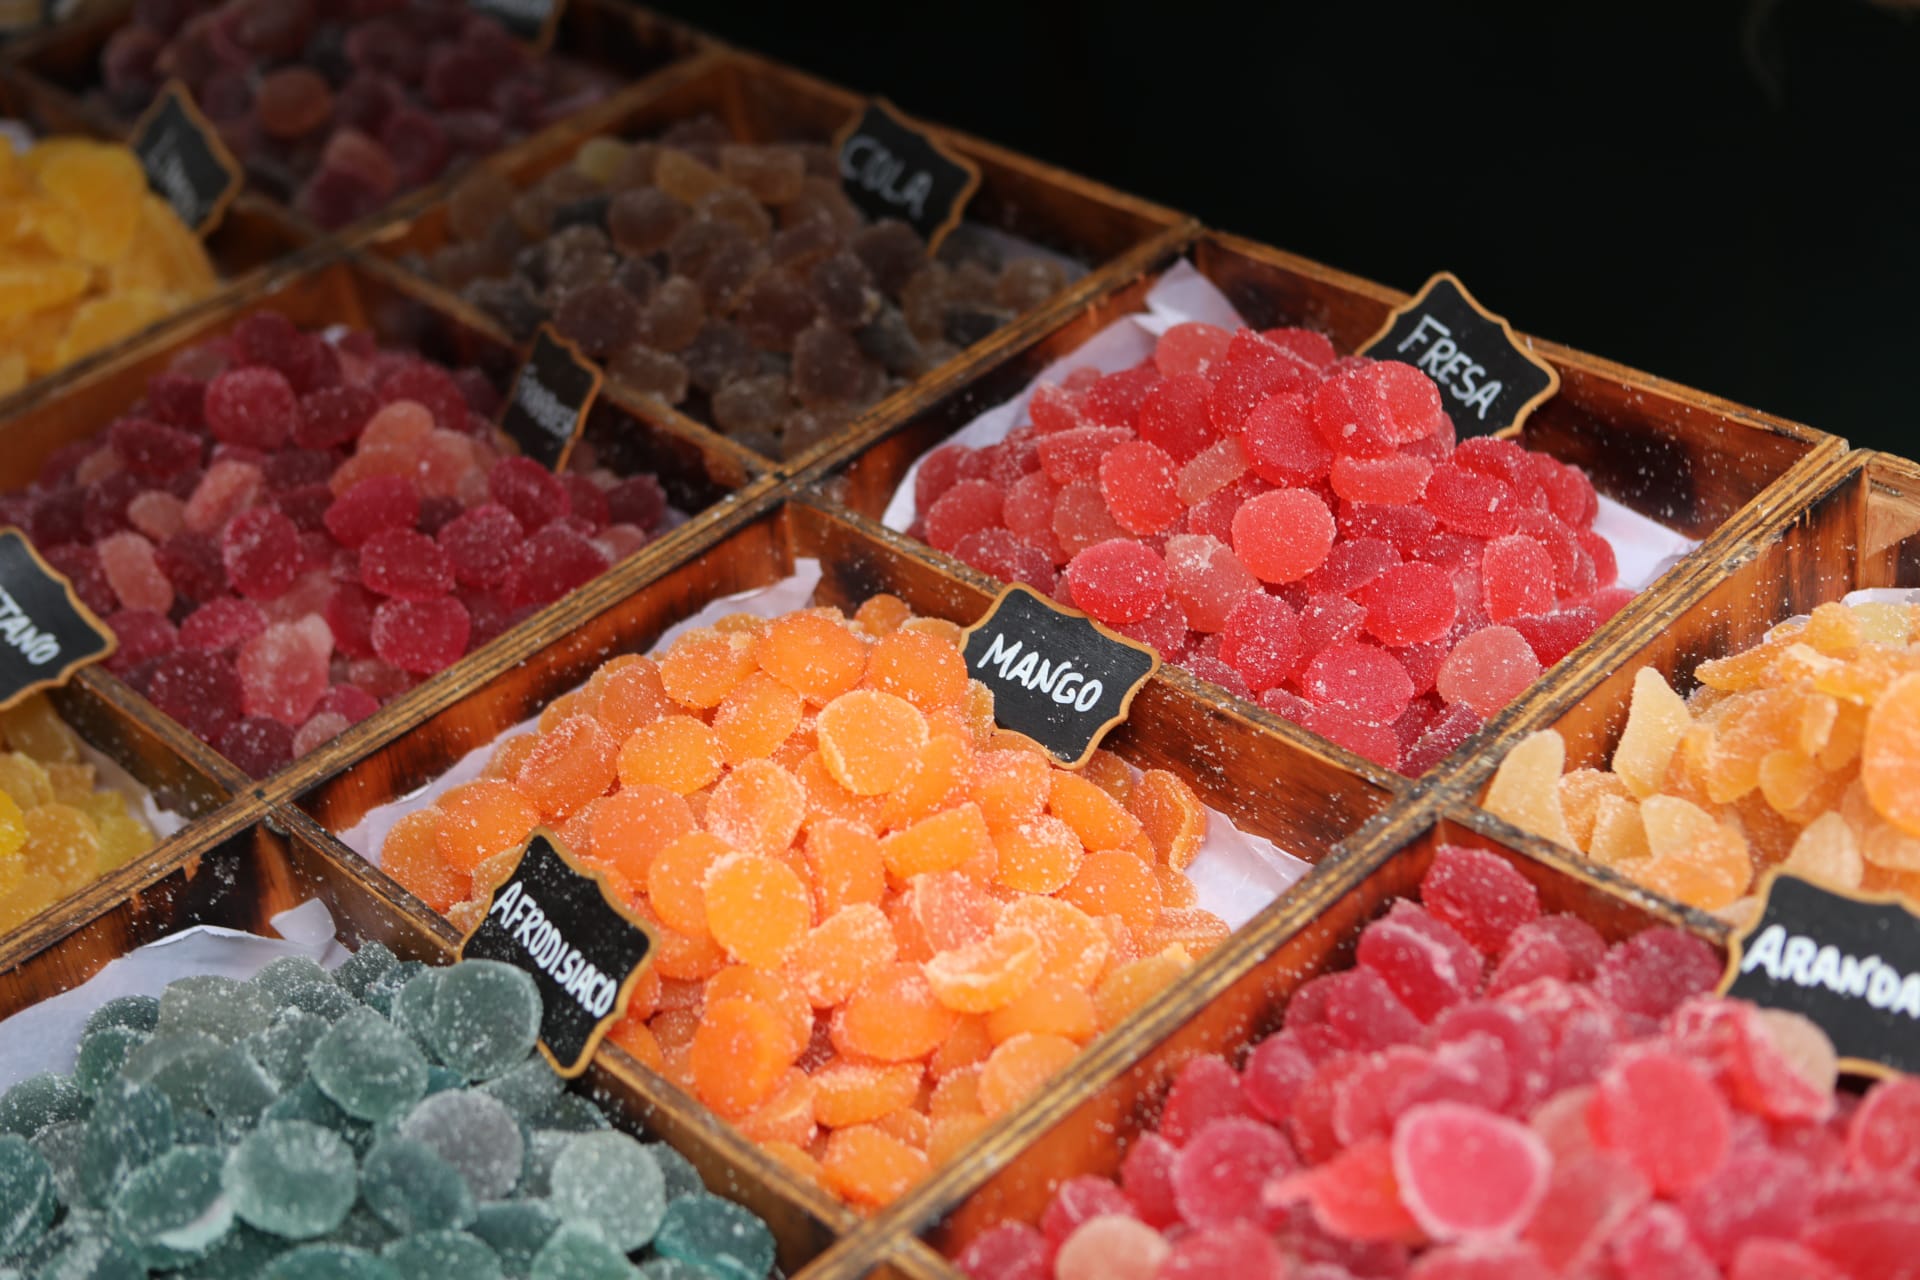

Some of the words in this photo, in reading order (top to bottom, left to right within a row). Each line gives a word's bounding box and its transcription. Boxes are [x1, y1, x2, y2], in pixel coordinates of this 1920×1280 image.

[840, 135, 932, 217] COLA
[1397, 314, 1502, 419] FRESA
[977, 634, 1103, 712] MANGO
[490, 880, 618, 1018] AFRODISIACO
